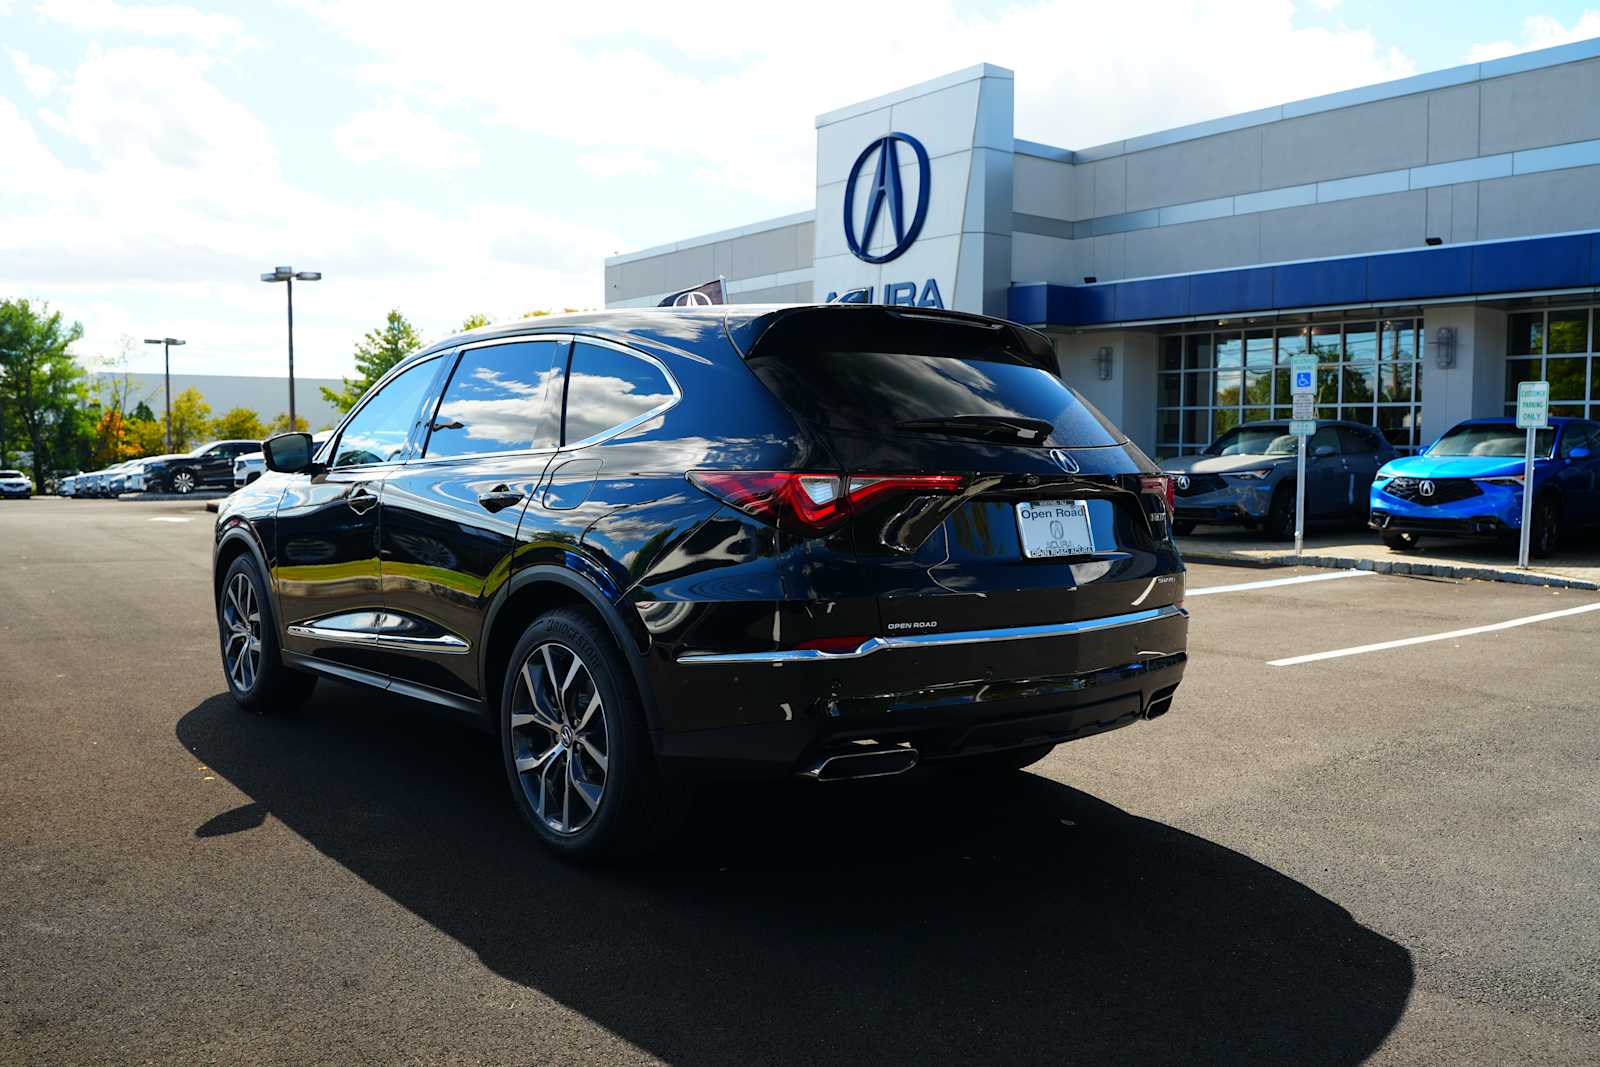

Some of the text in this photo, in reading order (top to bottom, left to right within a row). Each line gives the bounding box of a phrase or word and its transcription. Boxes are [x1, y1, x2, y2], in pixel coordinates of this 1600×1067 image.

[825, 278, 944, 309] URA
[1021, 507, 1085, 520] Open Road
[888, 621, 937, 630] OPEN ROAD
